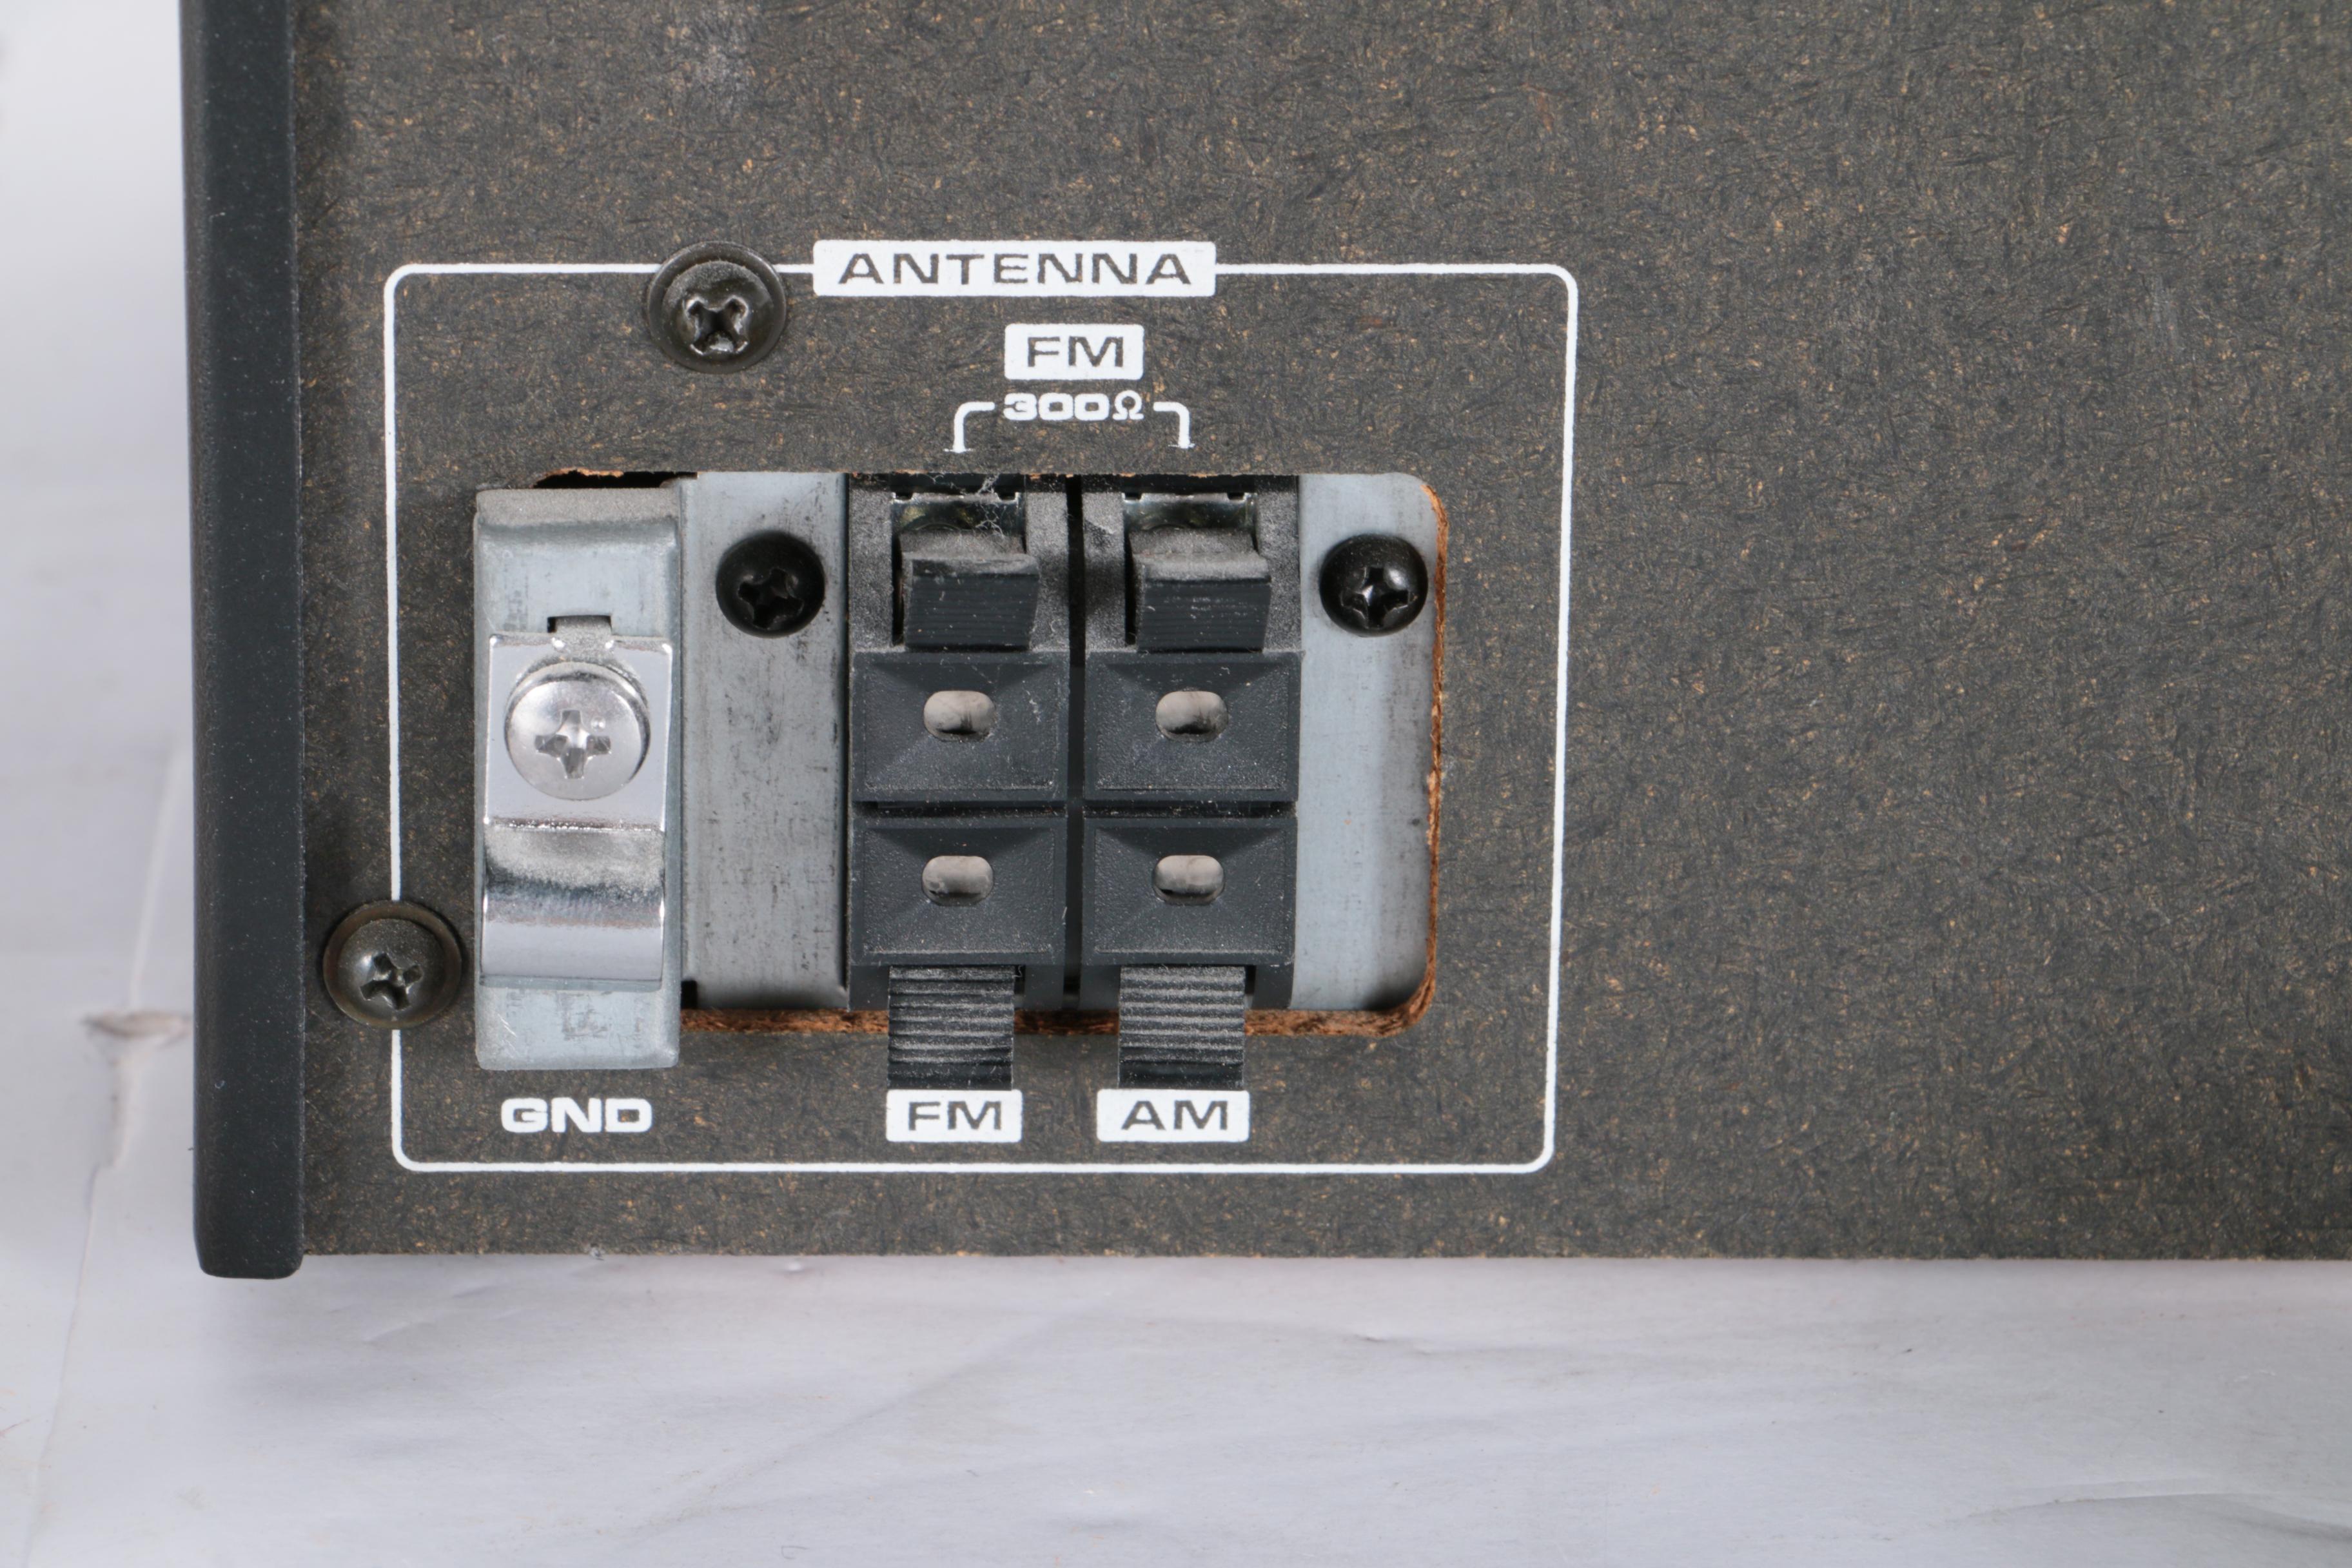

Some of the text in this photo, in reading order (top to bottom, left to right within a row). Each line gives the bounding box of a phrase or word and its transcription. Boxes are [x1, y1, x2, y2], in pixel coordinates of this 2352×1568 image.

[838, 252, 1191, 285] ANTENNA
[1026, 335, 1124, 368] FM
[1003, 389, 1144, 421] 300Ω
[500, 1097, 652, 1133] GND
[906, 1101, 1003, 1131] FM
[1120, 1101, 1228, 1131] AM
